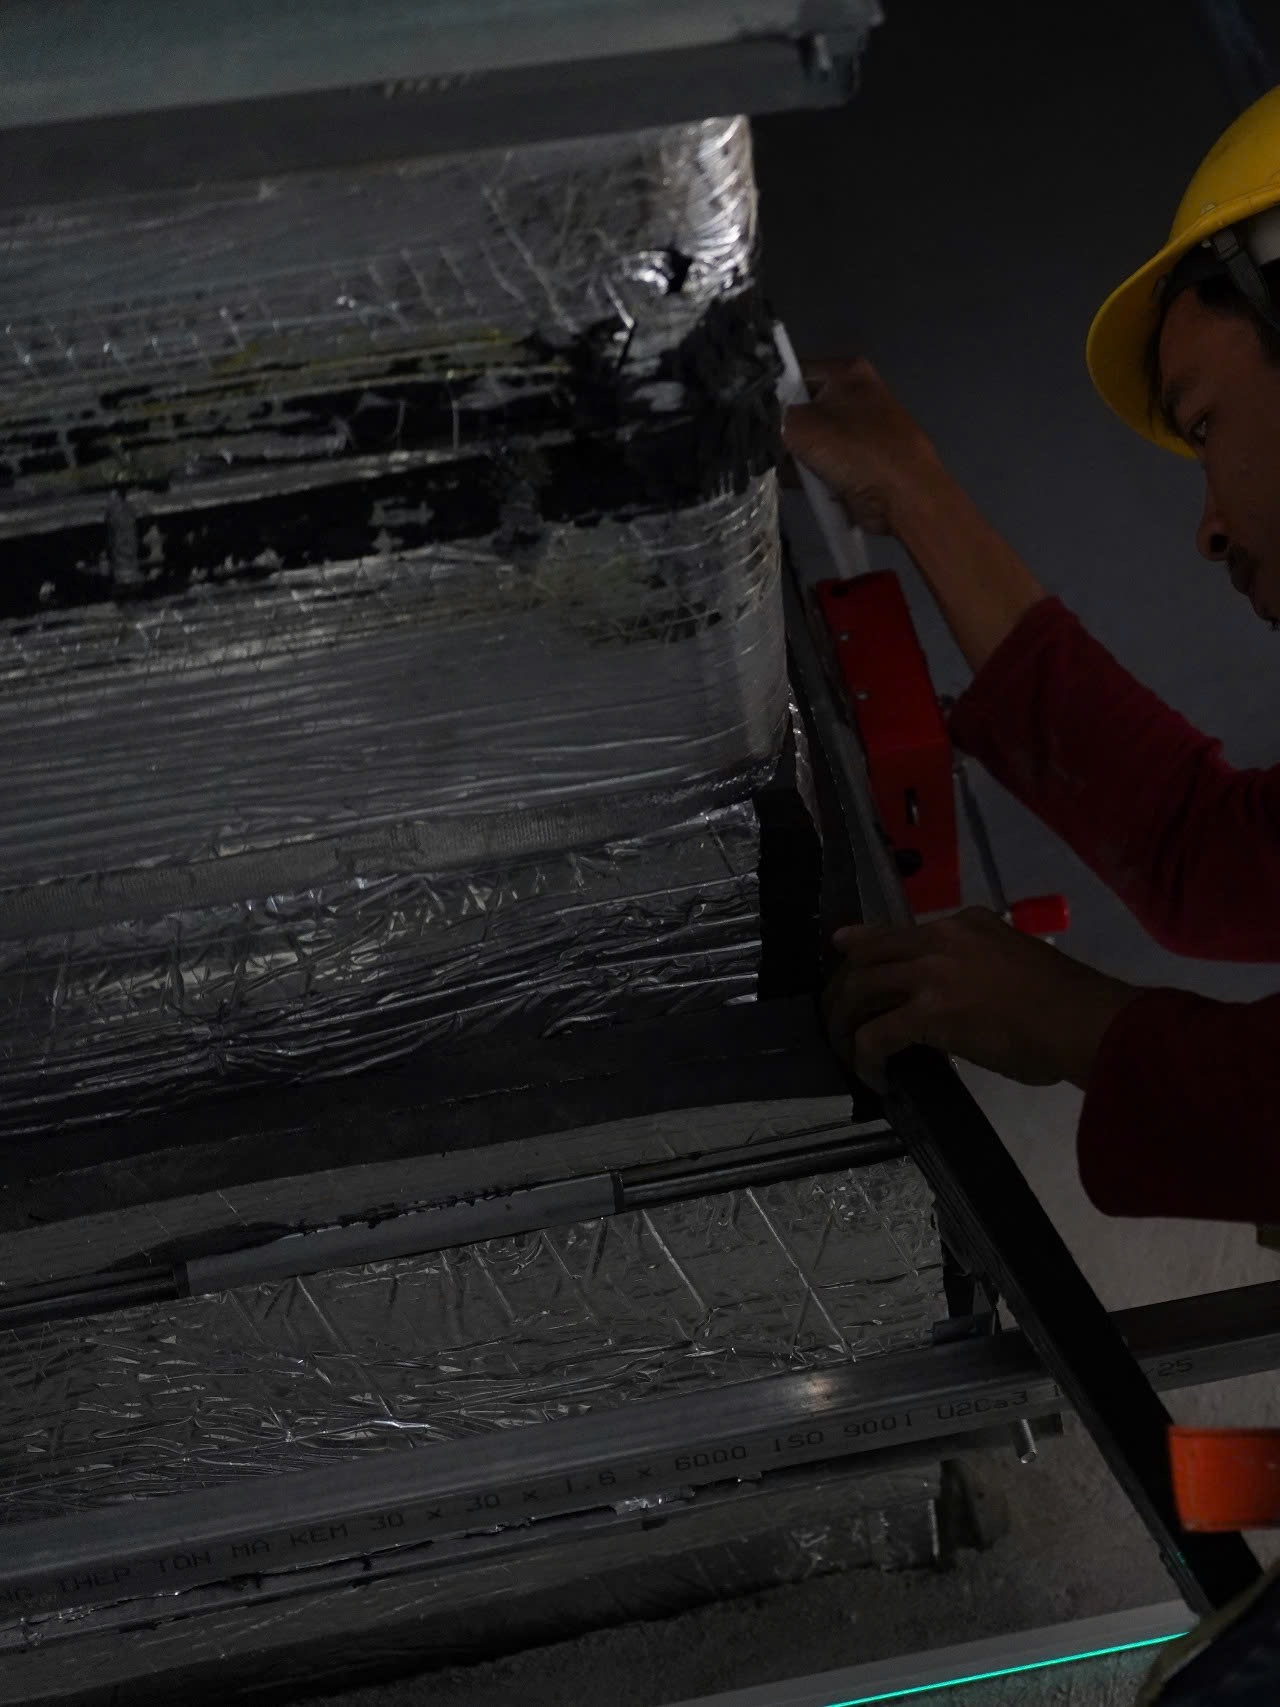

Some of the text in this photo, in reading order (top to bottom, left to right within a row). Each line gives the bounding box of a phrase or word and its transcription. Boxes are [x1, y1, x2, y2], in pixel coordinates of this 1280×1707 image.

[290, 1523, 348, 1546] KEM
[371, 1512, 404, 1530] 30
[466, 1493, 501, 1512] 30
[675, 1445, 748, 1471] 6000
[773, 1430, 825, 1453] ISO
[843, 1413, 913, 1438] 9001
